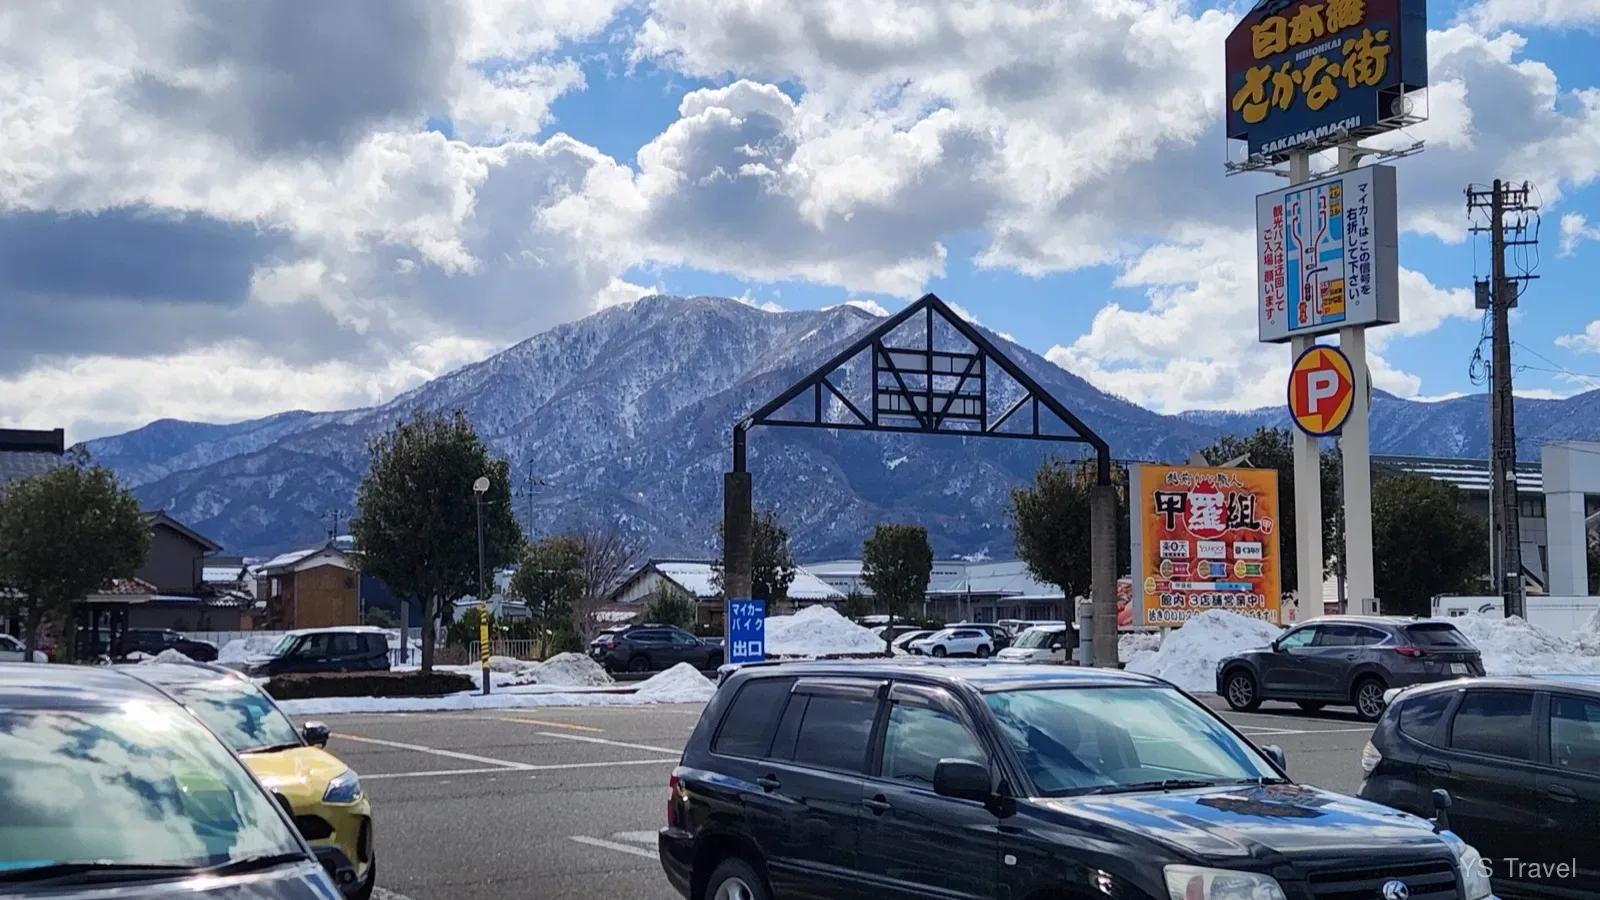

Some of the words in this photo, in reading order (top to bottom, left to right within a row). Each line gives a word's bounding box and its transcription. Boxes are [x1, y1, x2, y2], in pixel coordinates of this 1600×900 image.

[1251, 0, 1366, 58] 日本海
[1295, 38, 1341, 62] NIHONKAI
[1232, 28, 1391, 123] さかな街
[1261, 115, 1361, 154] SAKANAMACHI
[1272, 205, 1285, 312] 観光バスは迂回して
[1346, 207, 1360, 306] 右折して下さい。
[1307, 369, 1339, 414] P
[1154, 490, 1261, 532] 甲羅組
[732, 603, 762, 616] マイカー
[732, 618, 762, 631] バイク
[733, 640, 762, 657] 出口
